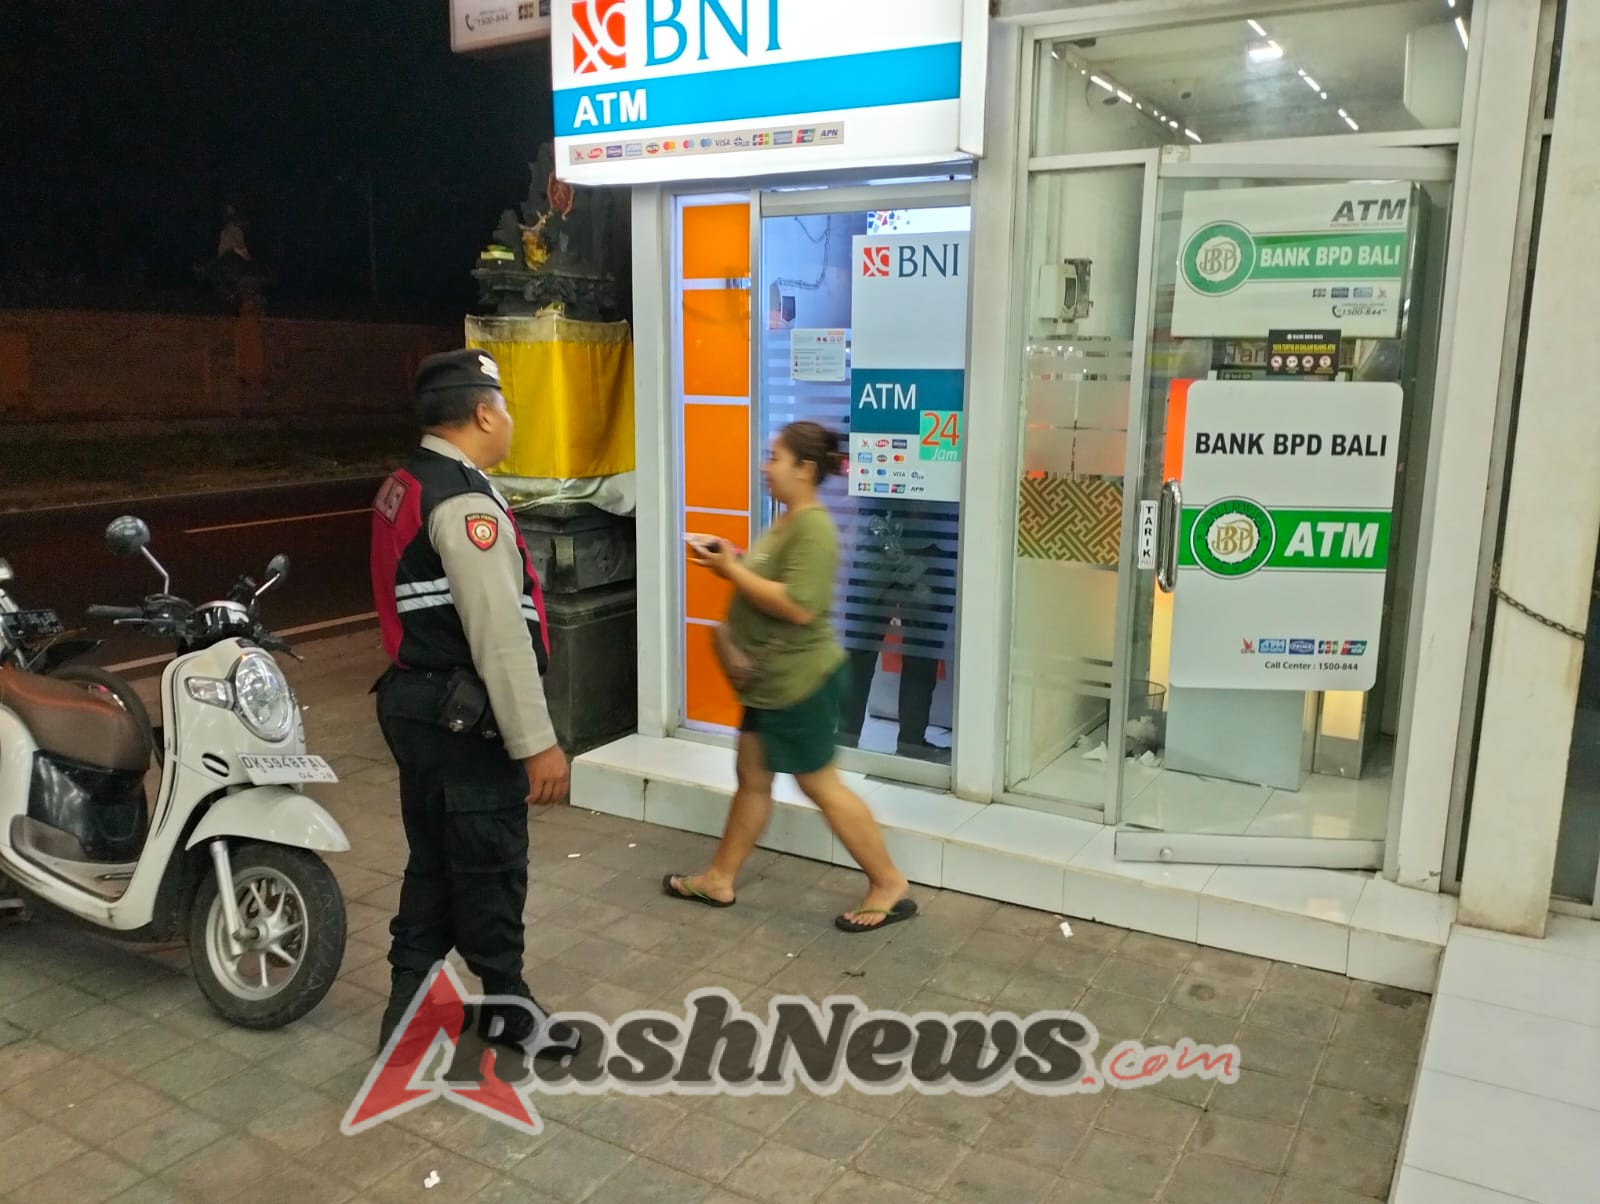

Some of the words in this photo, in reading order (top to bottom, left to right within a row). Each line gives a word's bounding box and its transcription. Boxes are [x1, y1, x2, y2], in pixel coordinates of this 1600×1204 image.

[644, 0, 783, 67] BNI
[572, 88, 648, 128] ATM
[715, 138, 731, 147] VISA
[821, 128, 838, 137] APN
[1331, 198, 1407, 222] ATM
[898, 243, 960, 278] BNI
[1260, 247, 1311, 267] BANK
[1315, 245, 1353, 266] BPD
[1357, 244, 1400, 265] BALI
[858, 383, 917, 410] ATM
[921, 411, 960, 447] 24
[1195, 432, 1265, 455] BANK
[1273, 433, 1323, 457] BPD
[1331, 434, 1388, 458] BALI
[1142, 505, 1154, 558] TARIK
[1283, 521, 1380, 559] ATM
[1264, 660, 1281, 670] Call
[1283, 661, 1311, 671] Center
[1318, 662, 1359, 671] 1500-844
